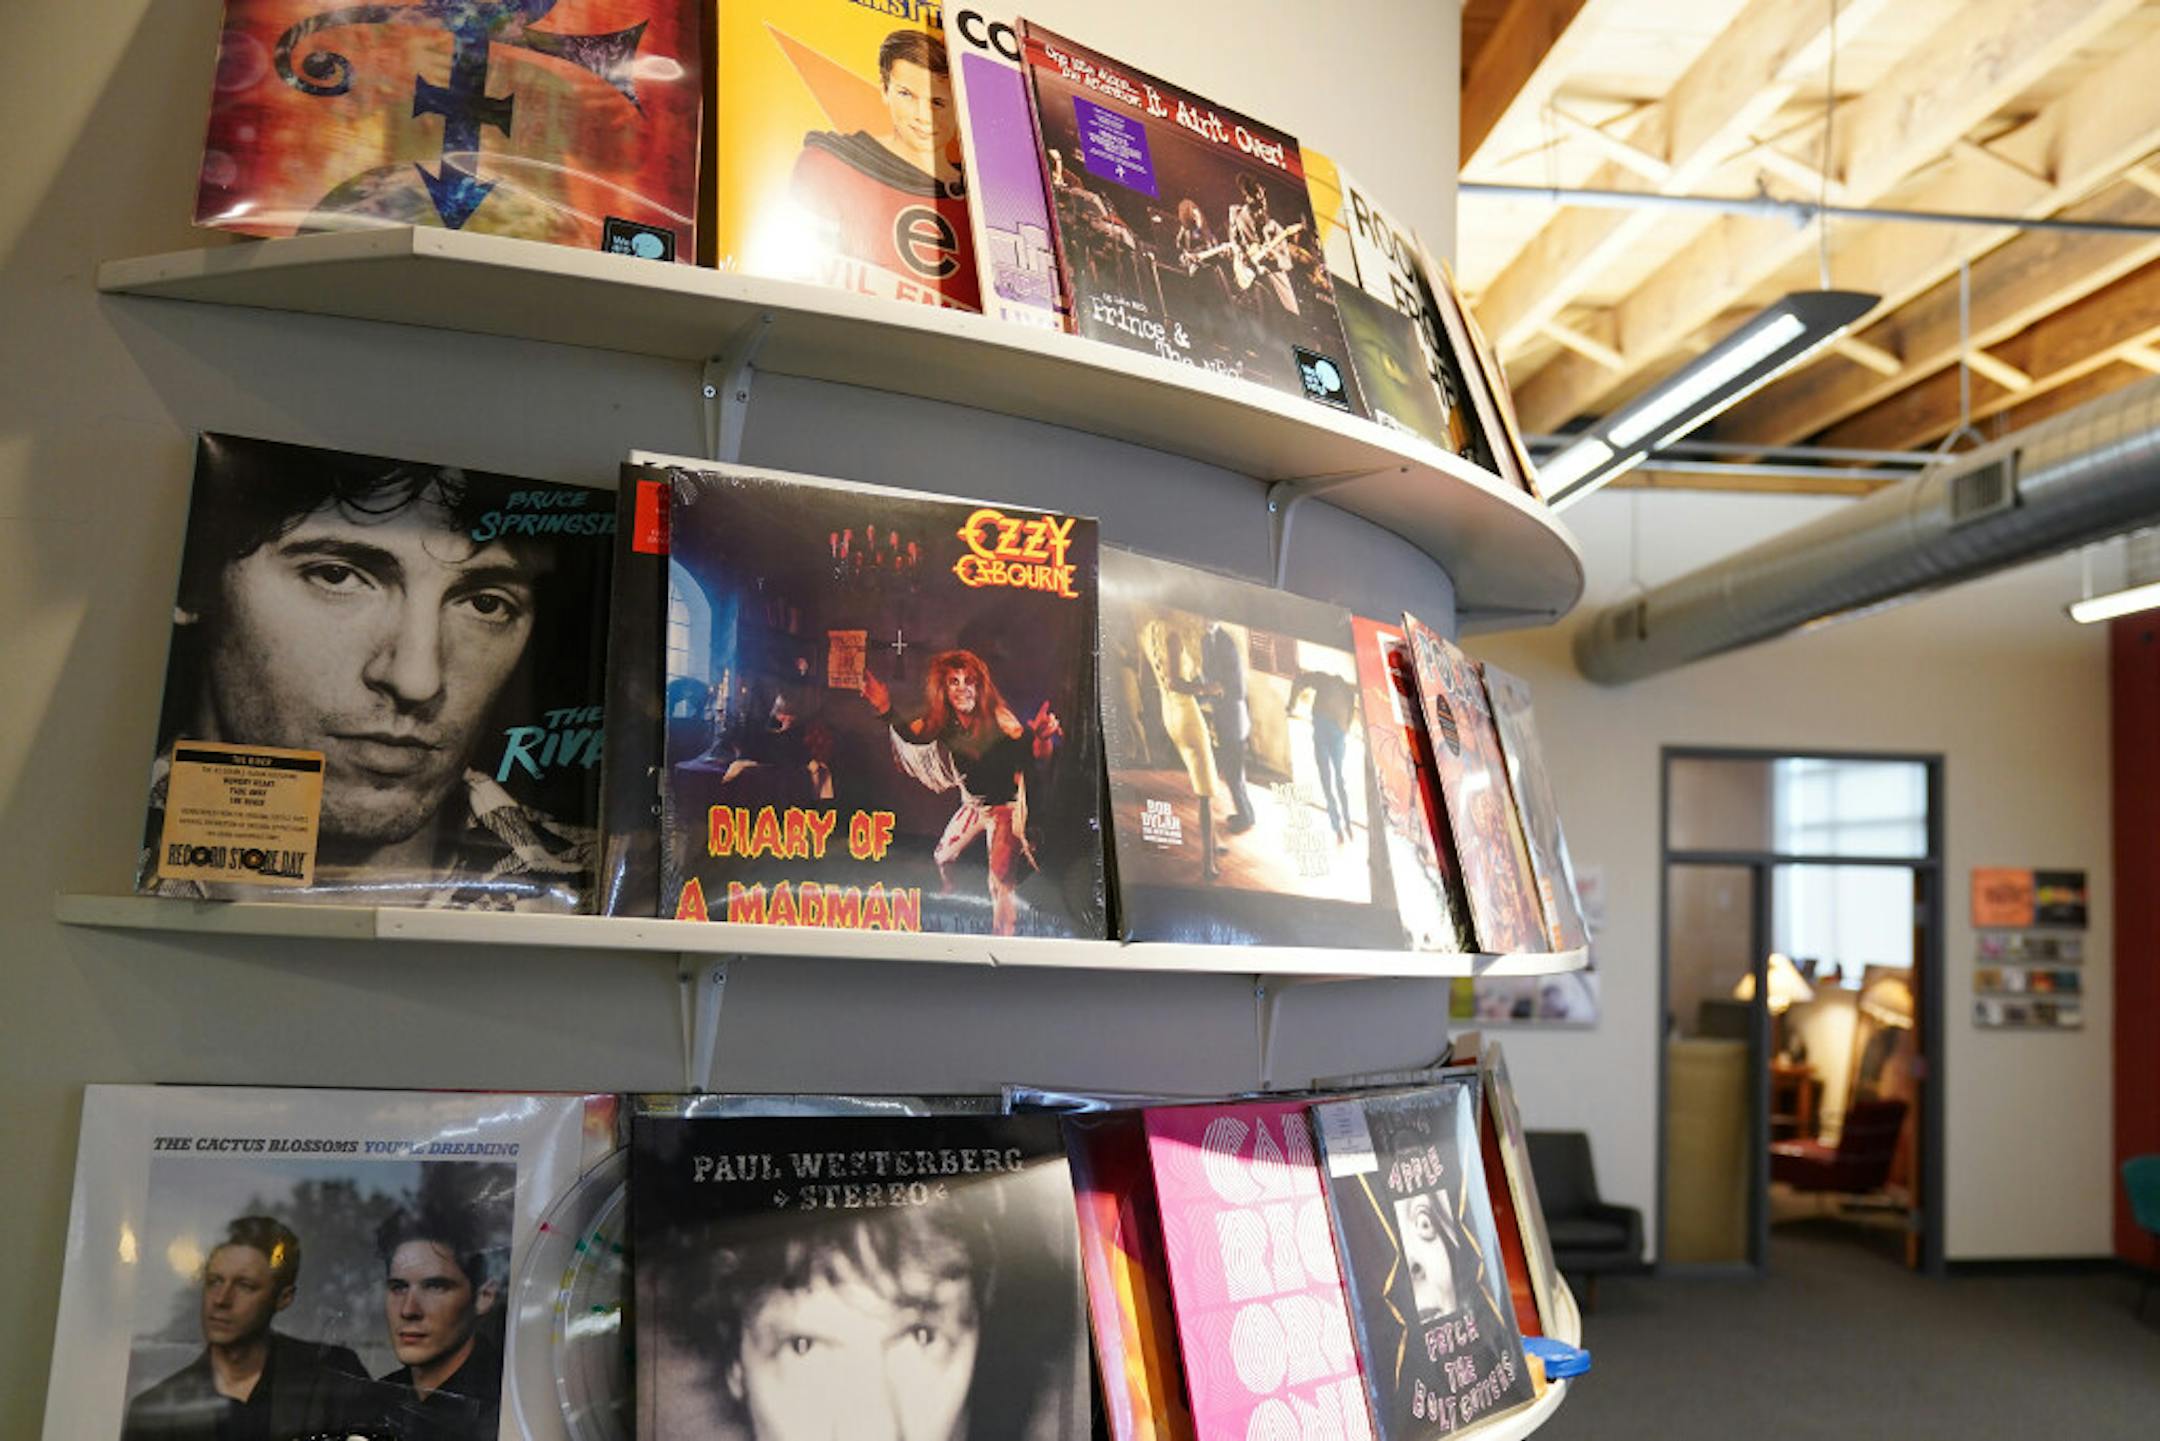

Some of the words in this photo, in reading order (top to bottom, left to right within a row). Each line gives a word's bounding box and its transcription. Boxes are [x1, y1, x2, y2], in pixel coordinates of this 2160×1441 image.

[1142, 83, 1168, 118] It
[1176, 100, 1229, 143] Ain't
[1234, 125, 1288, 170] Over!
[1090, 295, 1166, 341] Prince
[1173, 322, 1192, 349] &
[505, 490, 592, 510] BRUCE
[956, 508, 1077, 567] OZZY
[951, 553, 1081, 599] OSBOURNE
[544, 706, 604, 729] THE
[708, 804, 837, 861] DIARY
[849, 809, 896, 862] OF
[168, 843, 226, 869] RECORD
[228, 846, 277, 875] STORE
[281, 850, 308, 876] DAY
[675, 876, 709, 922] A
[727, 878, 922, 933] MADMAN
[154, 1137, 193, 1151] THE
[196, 1137, 266, 1152] CACTUS
[268, 1139, 360, 1154] BLOSSOMS
[427, 1141, 520, 1157] DREAMING
[692, 1155, 782, 1183] PAUL
[787, 1147, 1025, 1181] WESTERBERG
[1387, 1144, 1444, 1194] APPLE
[800, 1181, 930, 1211] STEREO
[1425, 1309, 1480, 1362] FETCH
[1444, 1355, 1477, 1394] THE
[1412, 1378, 1457, 1435] BOLT
